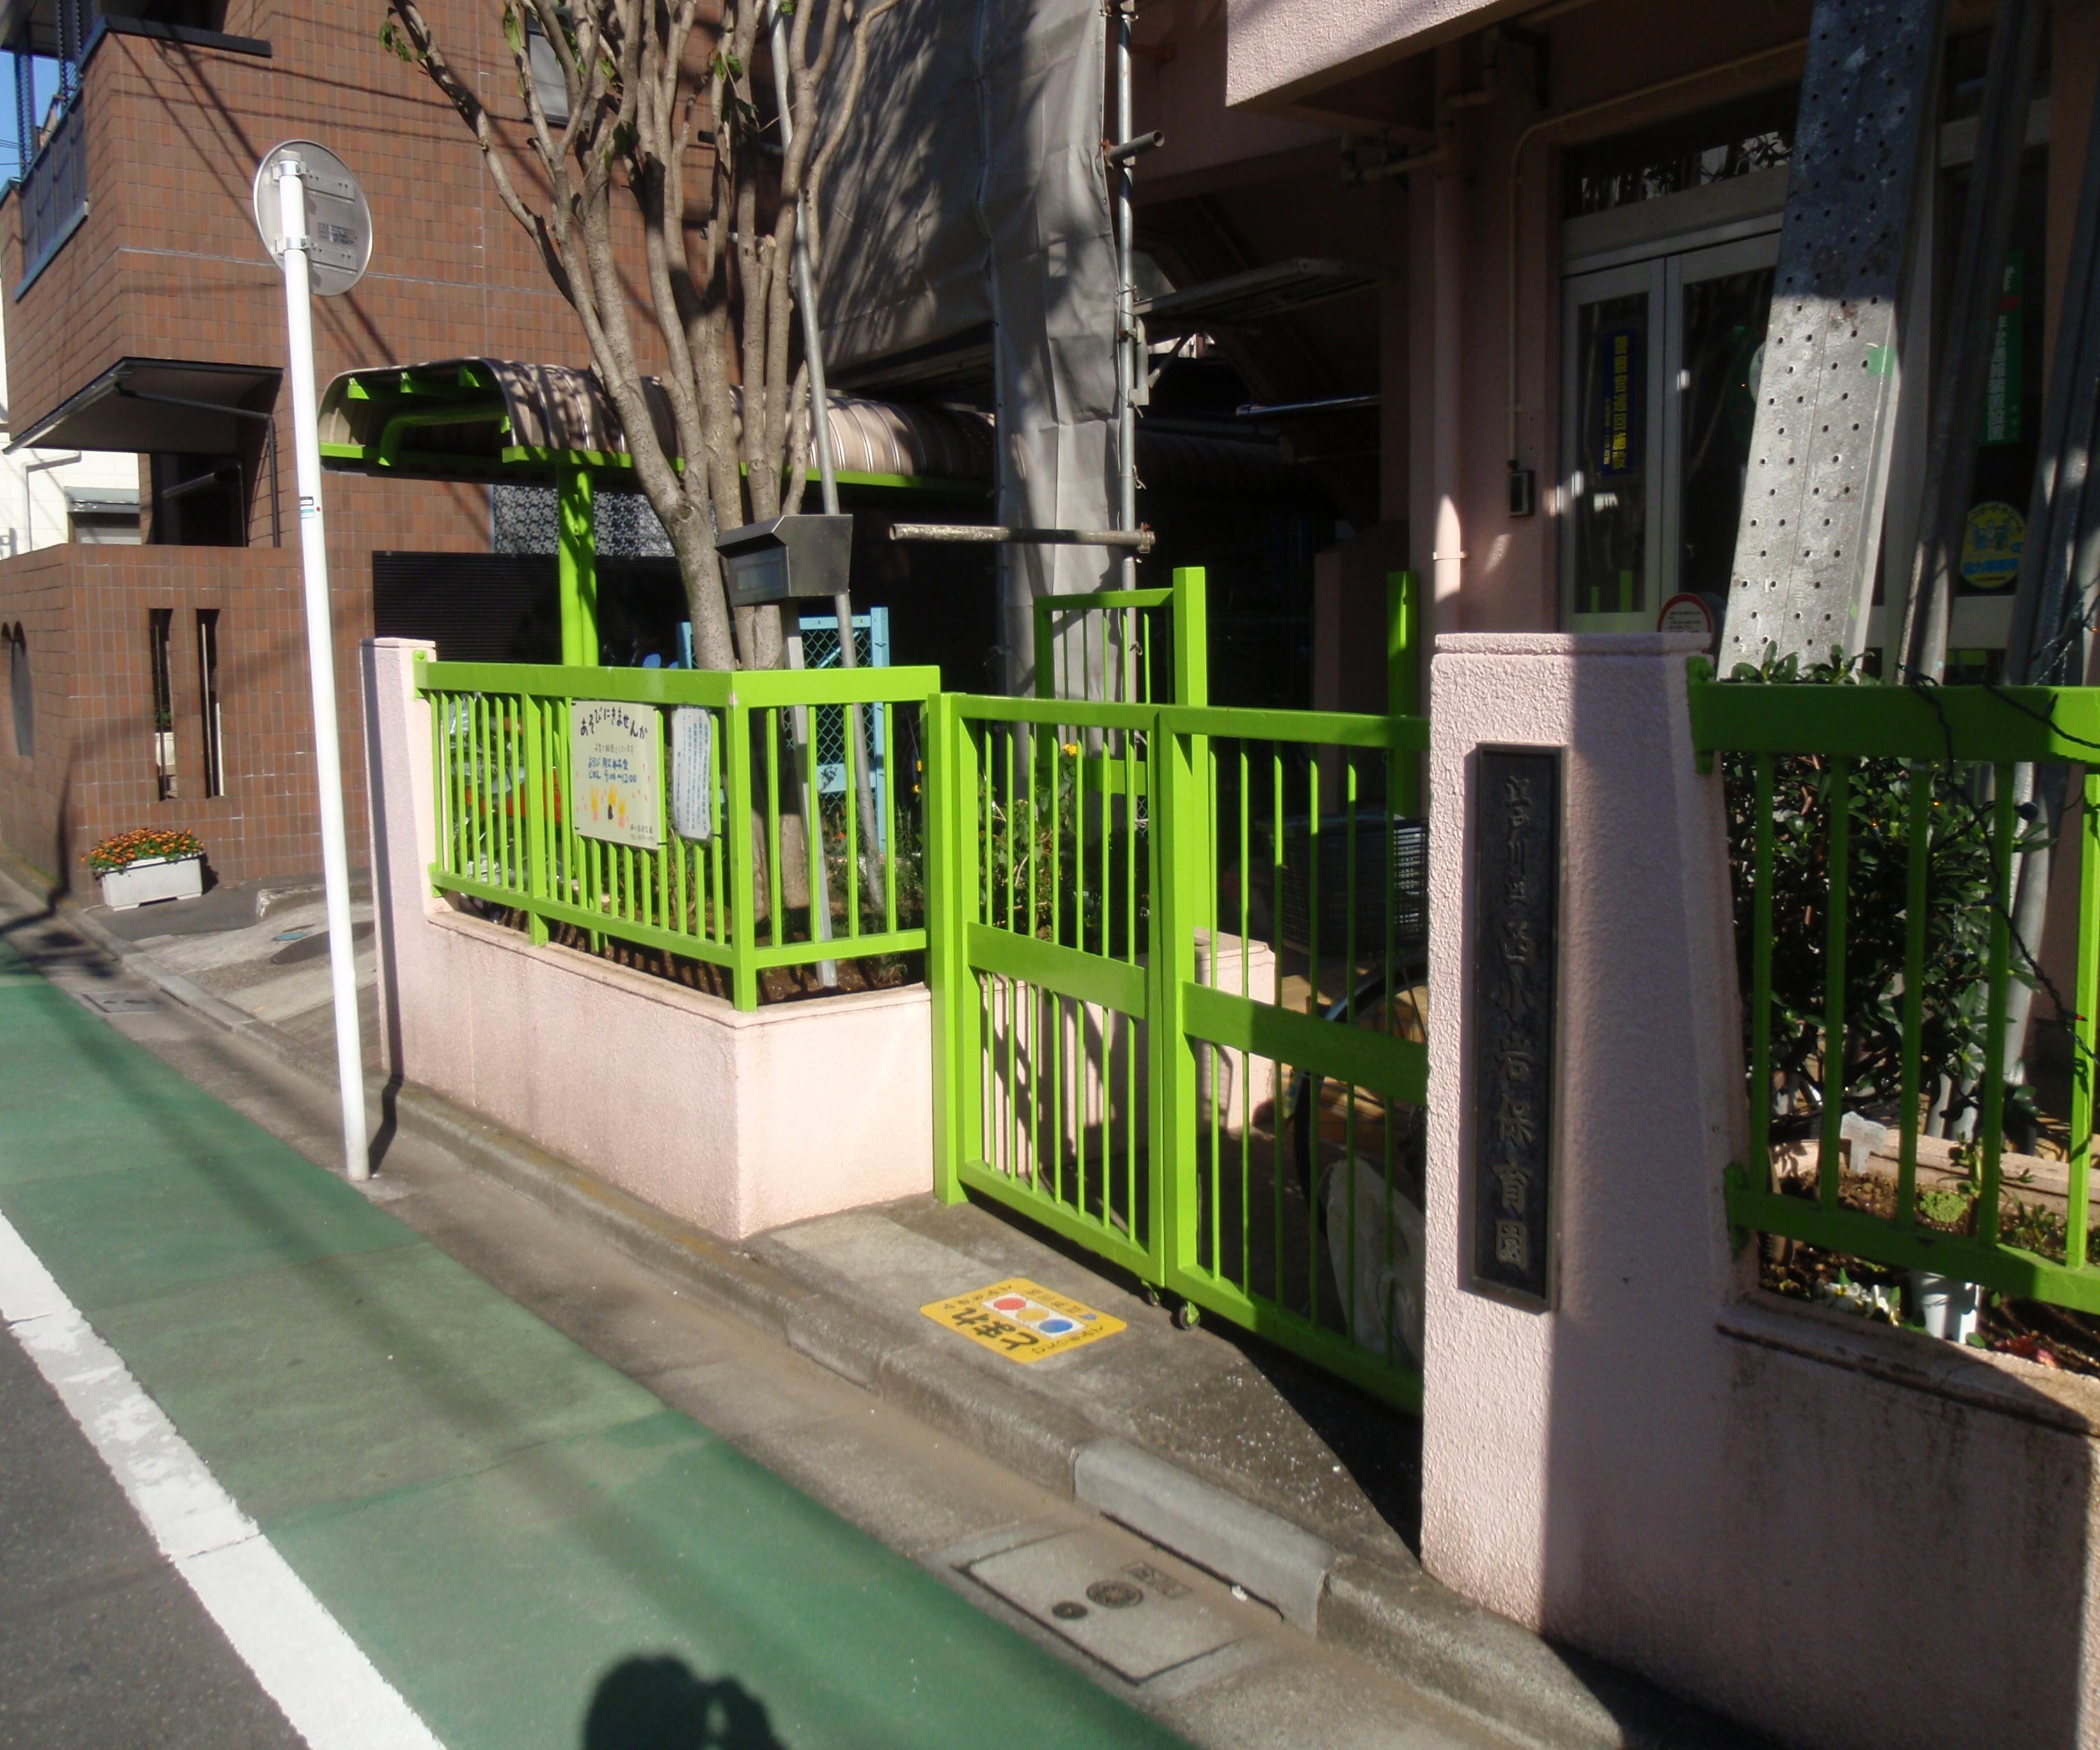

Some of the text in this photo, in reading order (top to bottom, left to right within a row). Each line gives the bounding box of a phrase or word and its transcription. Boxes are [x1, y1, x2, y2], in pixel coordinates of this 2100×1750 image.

[581, 706, 648, 739] あそびにきませんか
[952, 1307, 1039, 1351] とまれ
